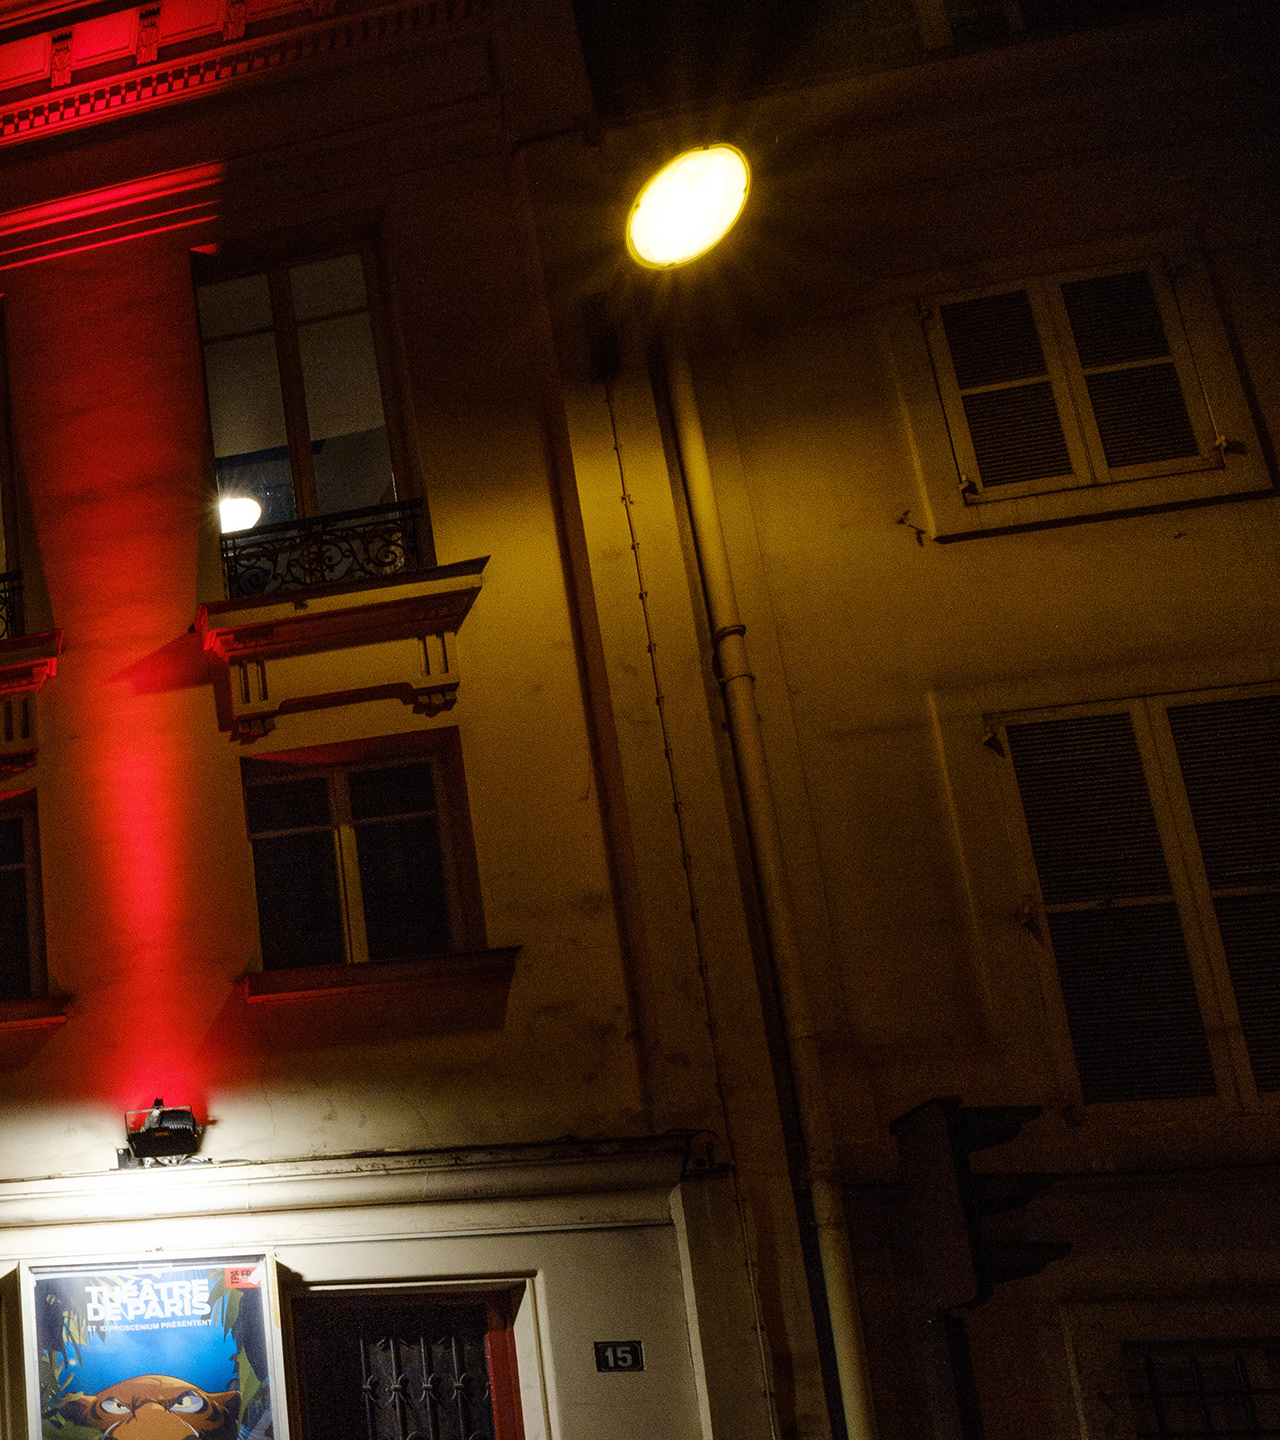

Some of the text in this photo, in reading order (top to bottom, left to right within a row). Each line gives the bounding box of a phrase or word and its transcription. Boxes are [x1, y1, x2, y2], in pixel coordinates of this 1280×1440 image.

[85, 1278, 210, 1303] THÉÂTRE
[86, 1298, 211, 1322] DE PARIS
[604, 1346, 633, 1367] 15
